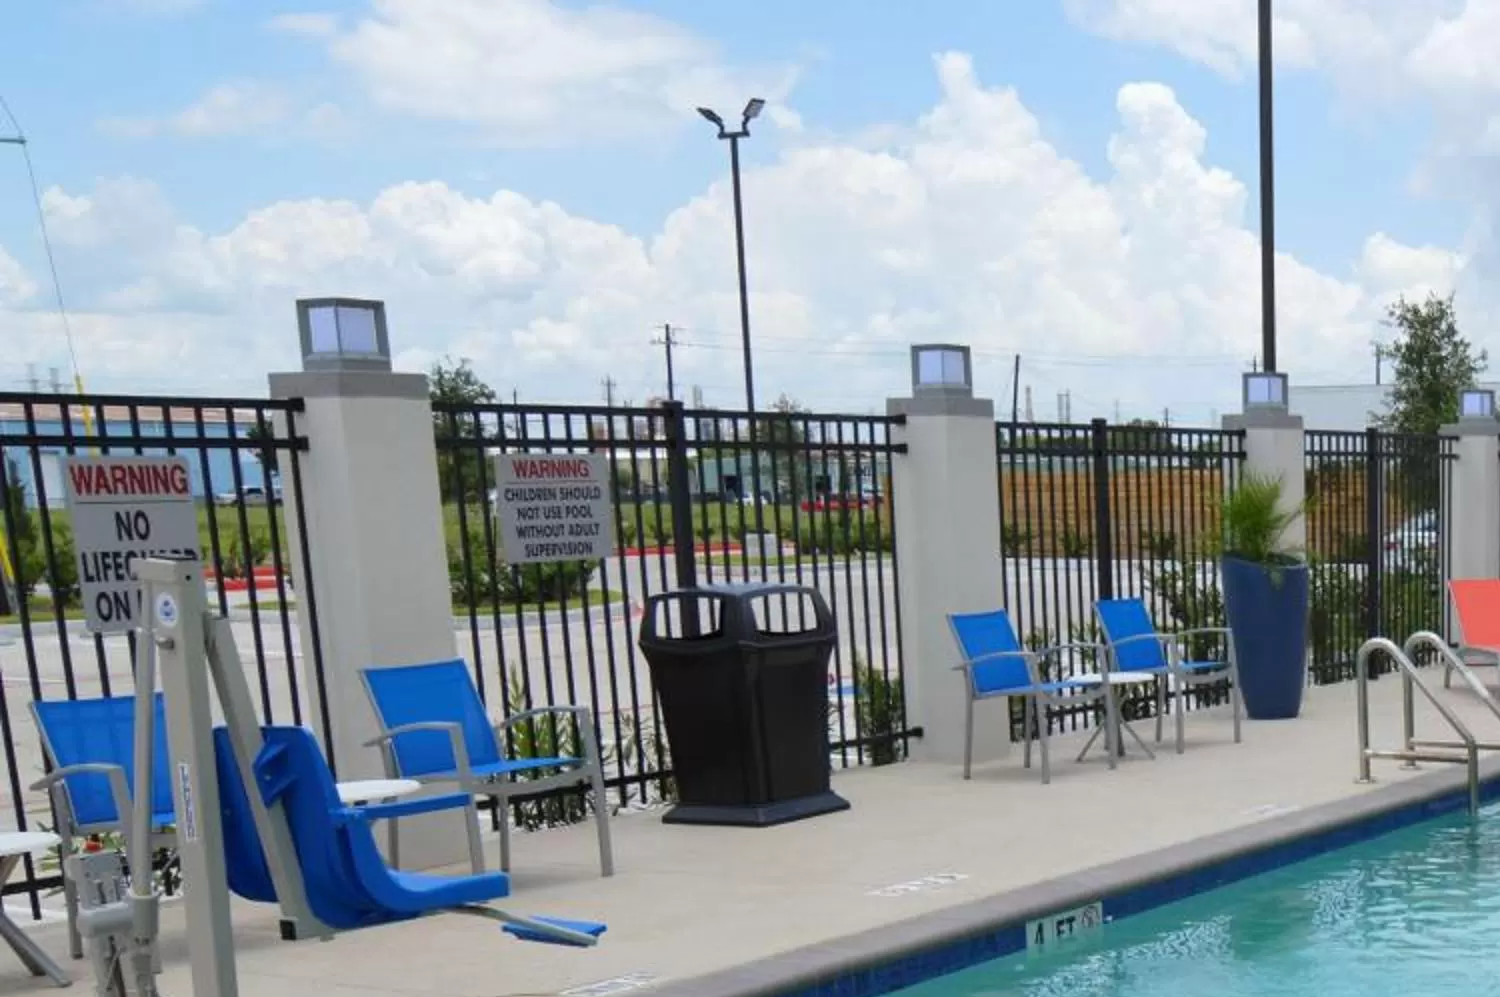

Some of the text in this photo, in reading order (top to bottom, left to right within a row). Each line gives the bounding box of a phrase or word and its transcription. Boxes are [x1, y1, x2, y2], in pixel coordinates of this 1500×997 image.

[511, 459, 590, 479] WARNING
[69, 464, 190, 496] WARNING
[503, 486, 602, 501] CHILDREN SHOULD
[517, 504, 593, 520] NOT USE POOL
[115, 510, 150, 541] NO
[516, 523, 600, 539] WITHOUT ADULT
[524, 541, 593, 558] SUPERVISION
[96, 590, 132, 622] ON
[1056, 915, 1076, 937] FT
